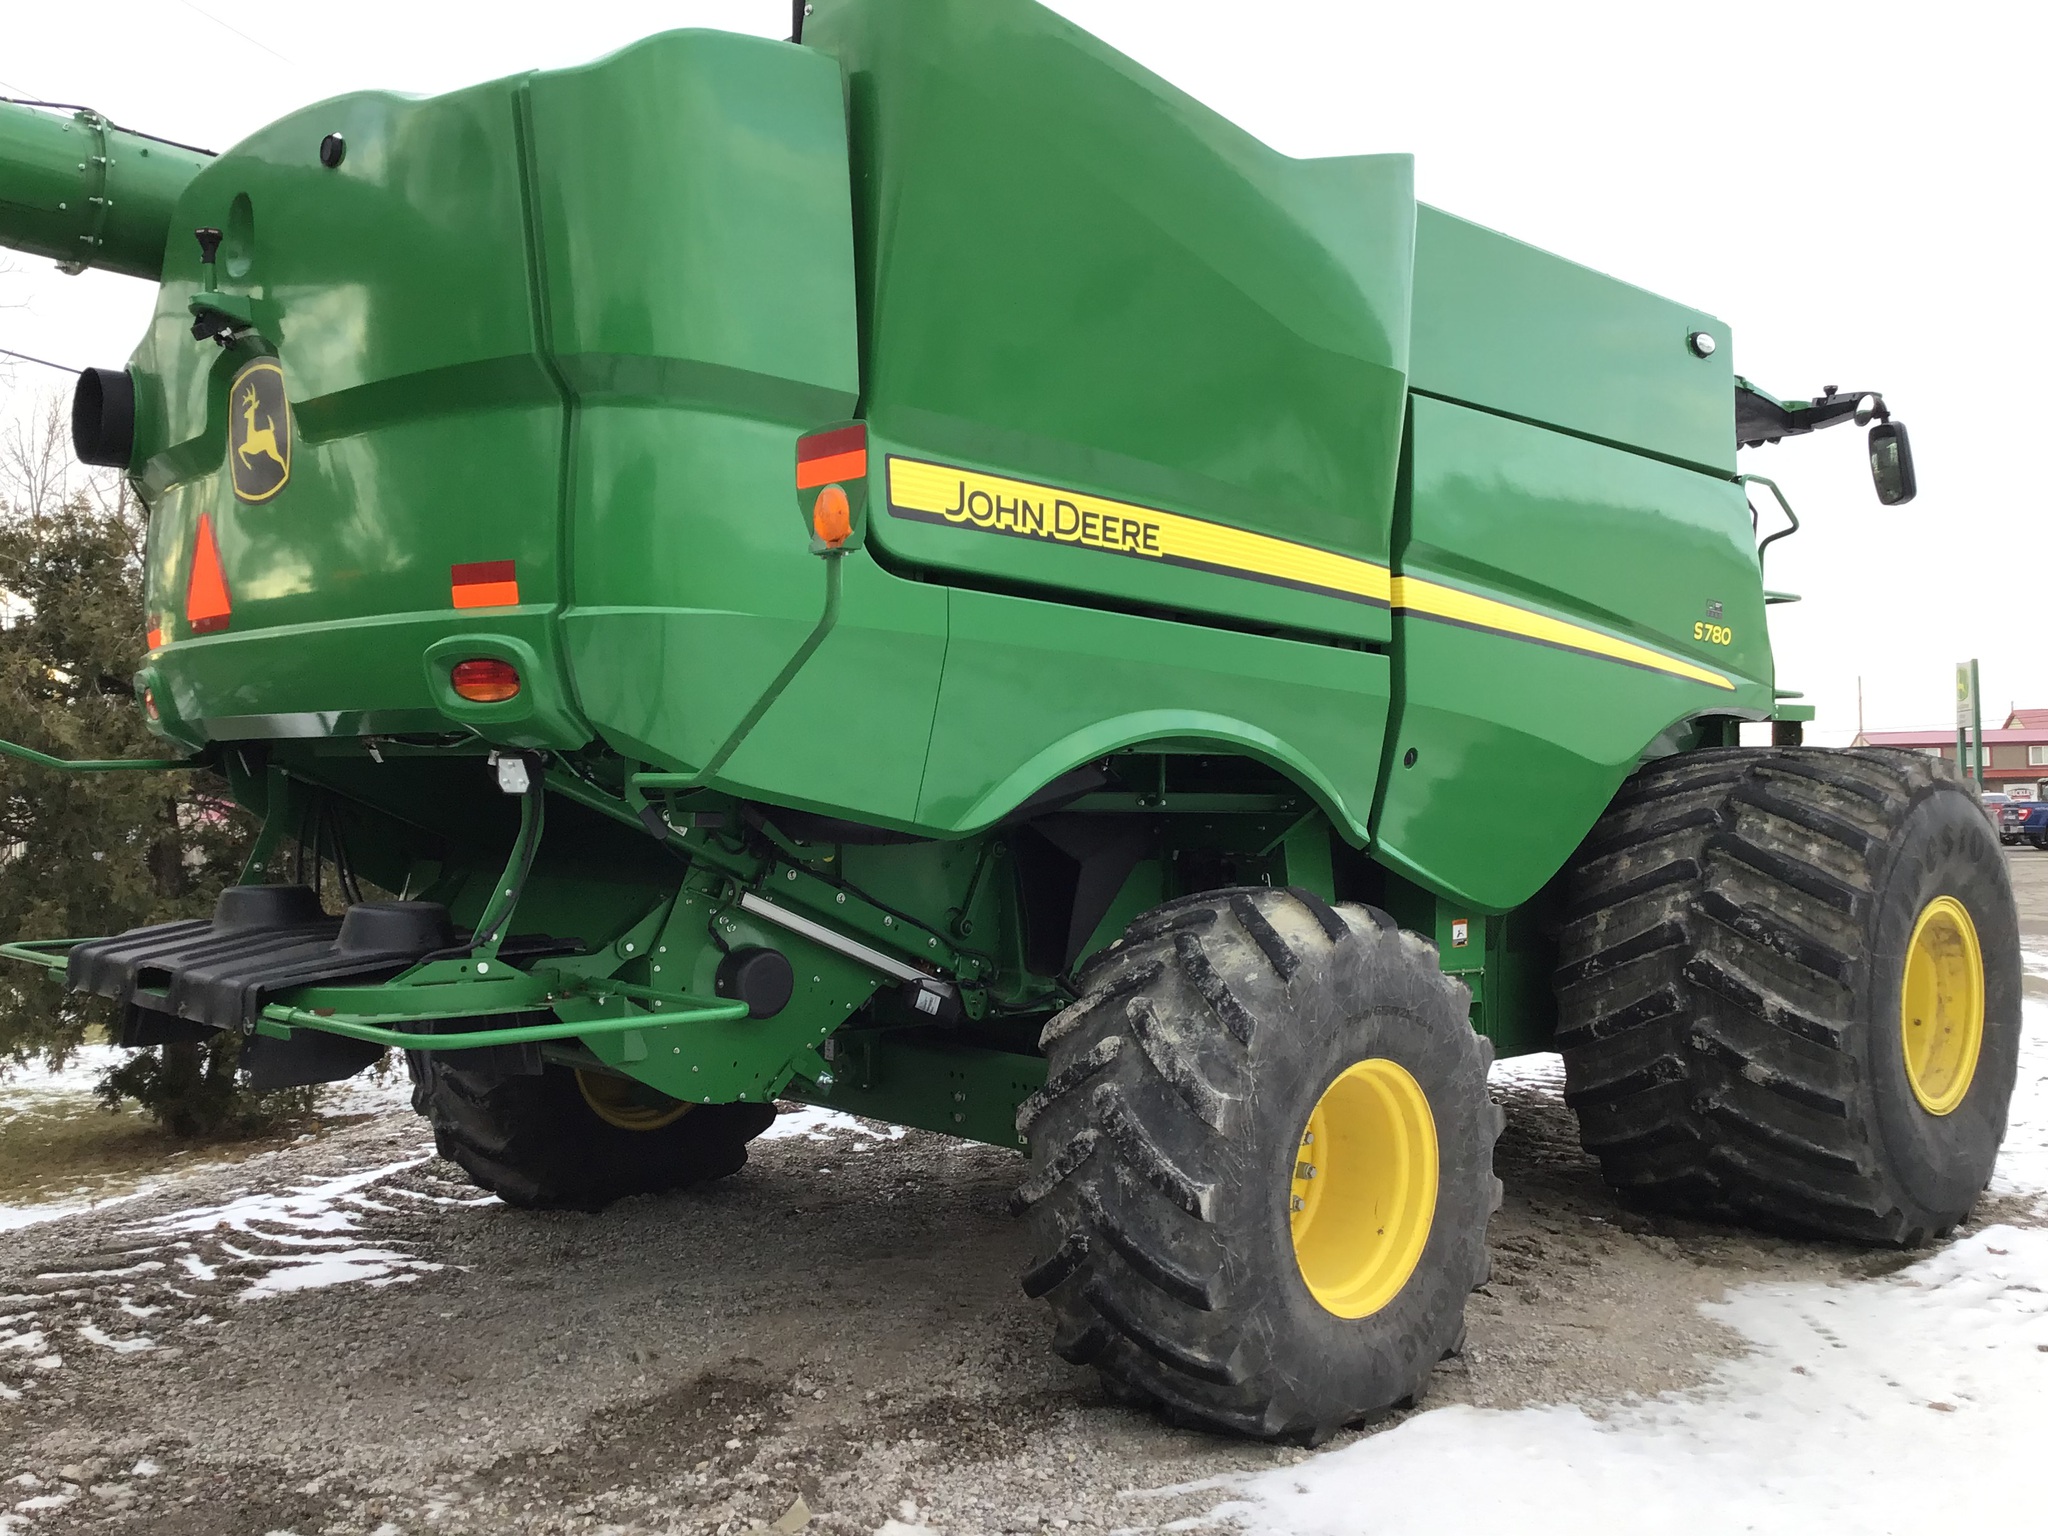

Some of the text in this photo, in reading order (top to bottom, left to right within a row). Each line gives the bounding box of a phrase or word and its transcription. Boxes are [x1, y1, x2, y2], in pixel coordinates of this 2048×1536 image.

[945, 481, 1160, 551] JOHN DEERE
[1693, 621, 1732, 646] S780
